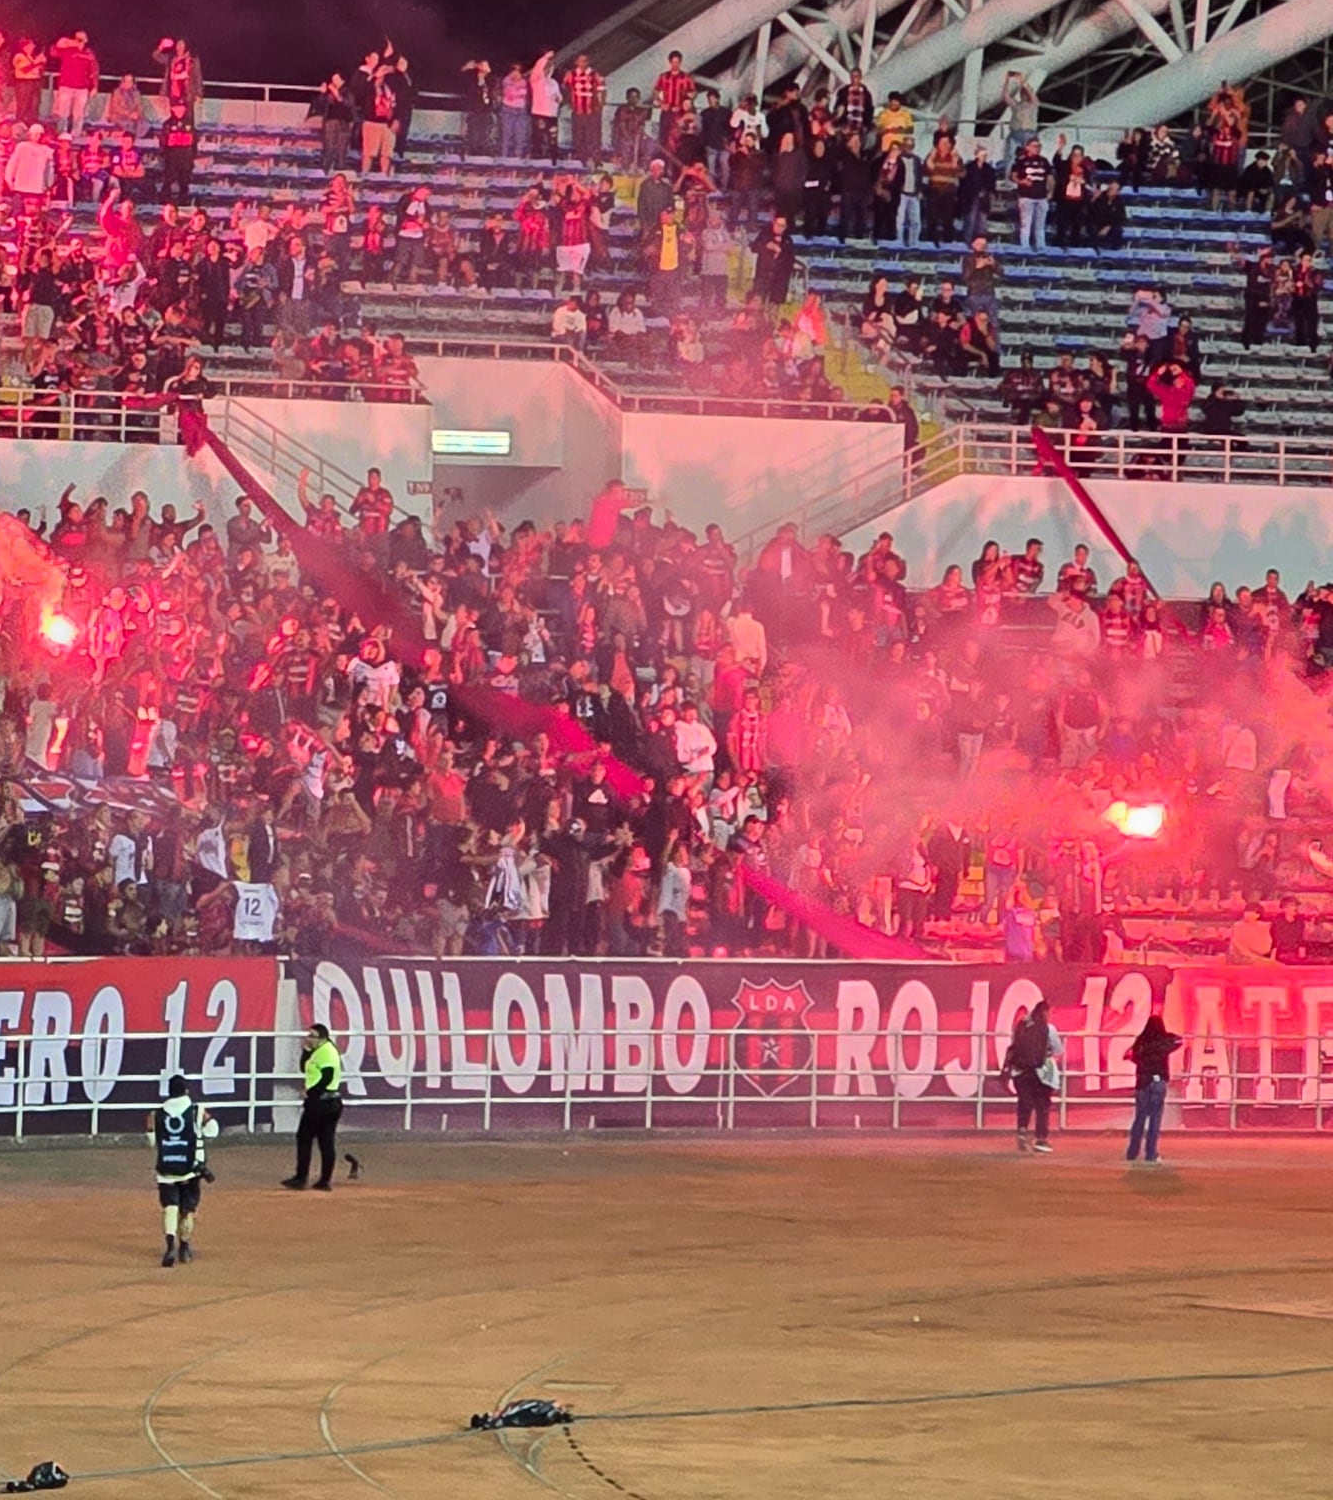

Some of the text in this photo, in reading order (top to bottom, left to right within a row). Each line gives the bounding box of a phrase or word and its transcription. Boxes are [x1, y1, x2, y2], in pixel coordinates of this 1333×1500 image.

[244, 897, 262, 917] 12
[160, 978, 237, 1097] 12
[312, 961, 711, 1096] QUILOMBO
[1081, 972, 1152, 1091] 12
[748, 994, 796, 1012] LDA
